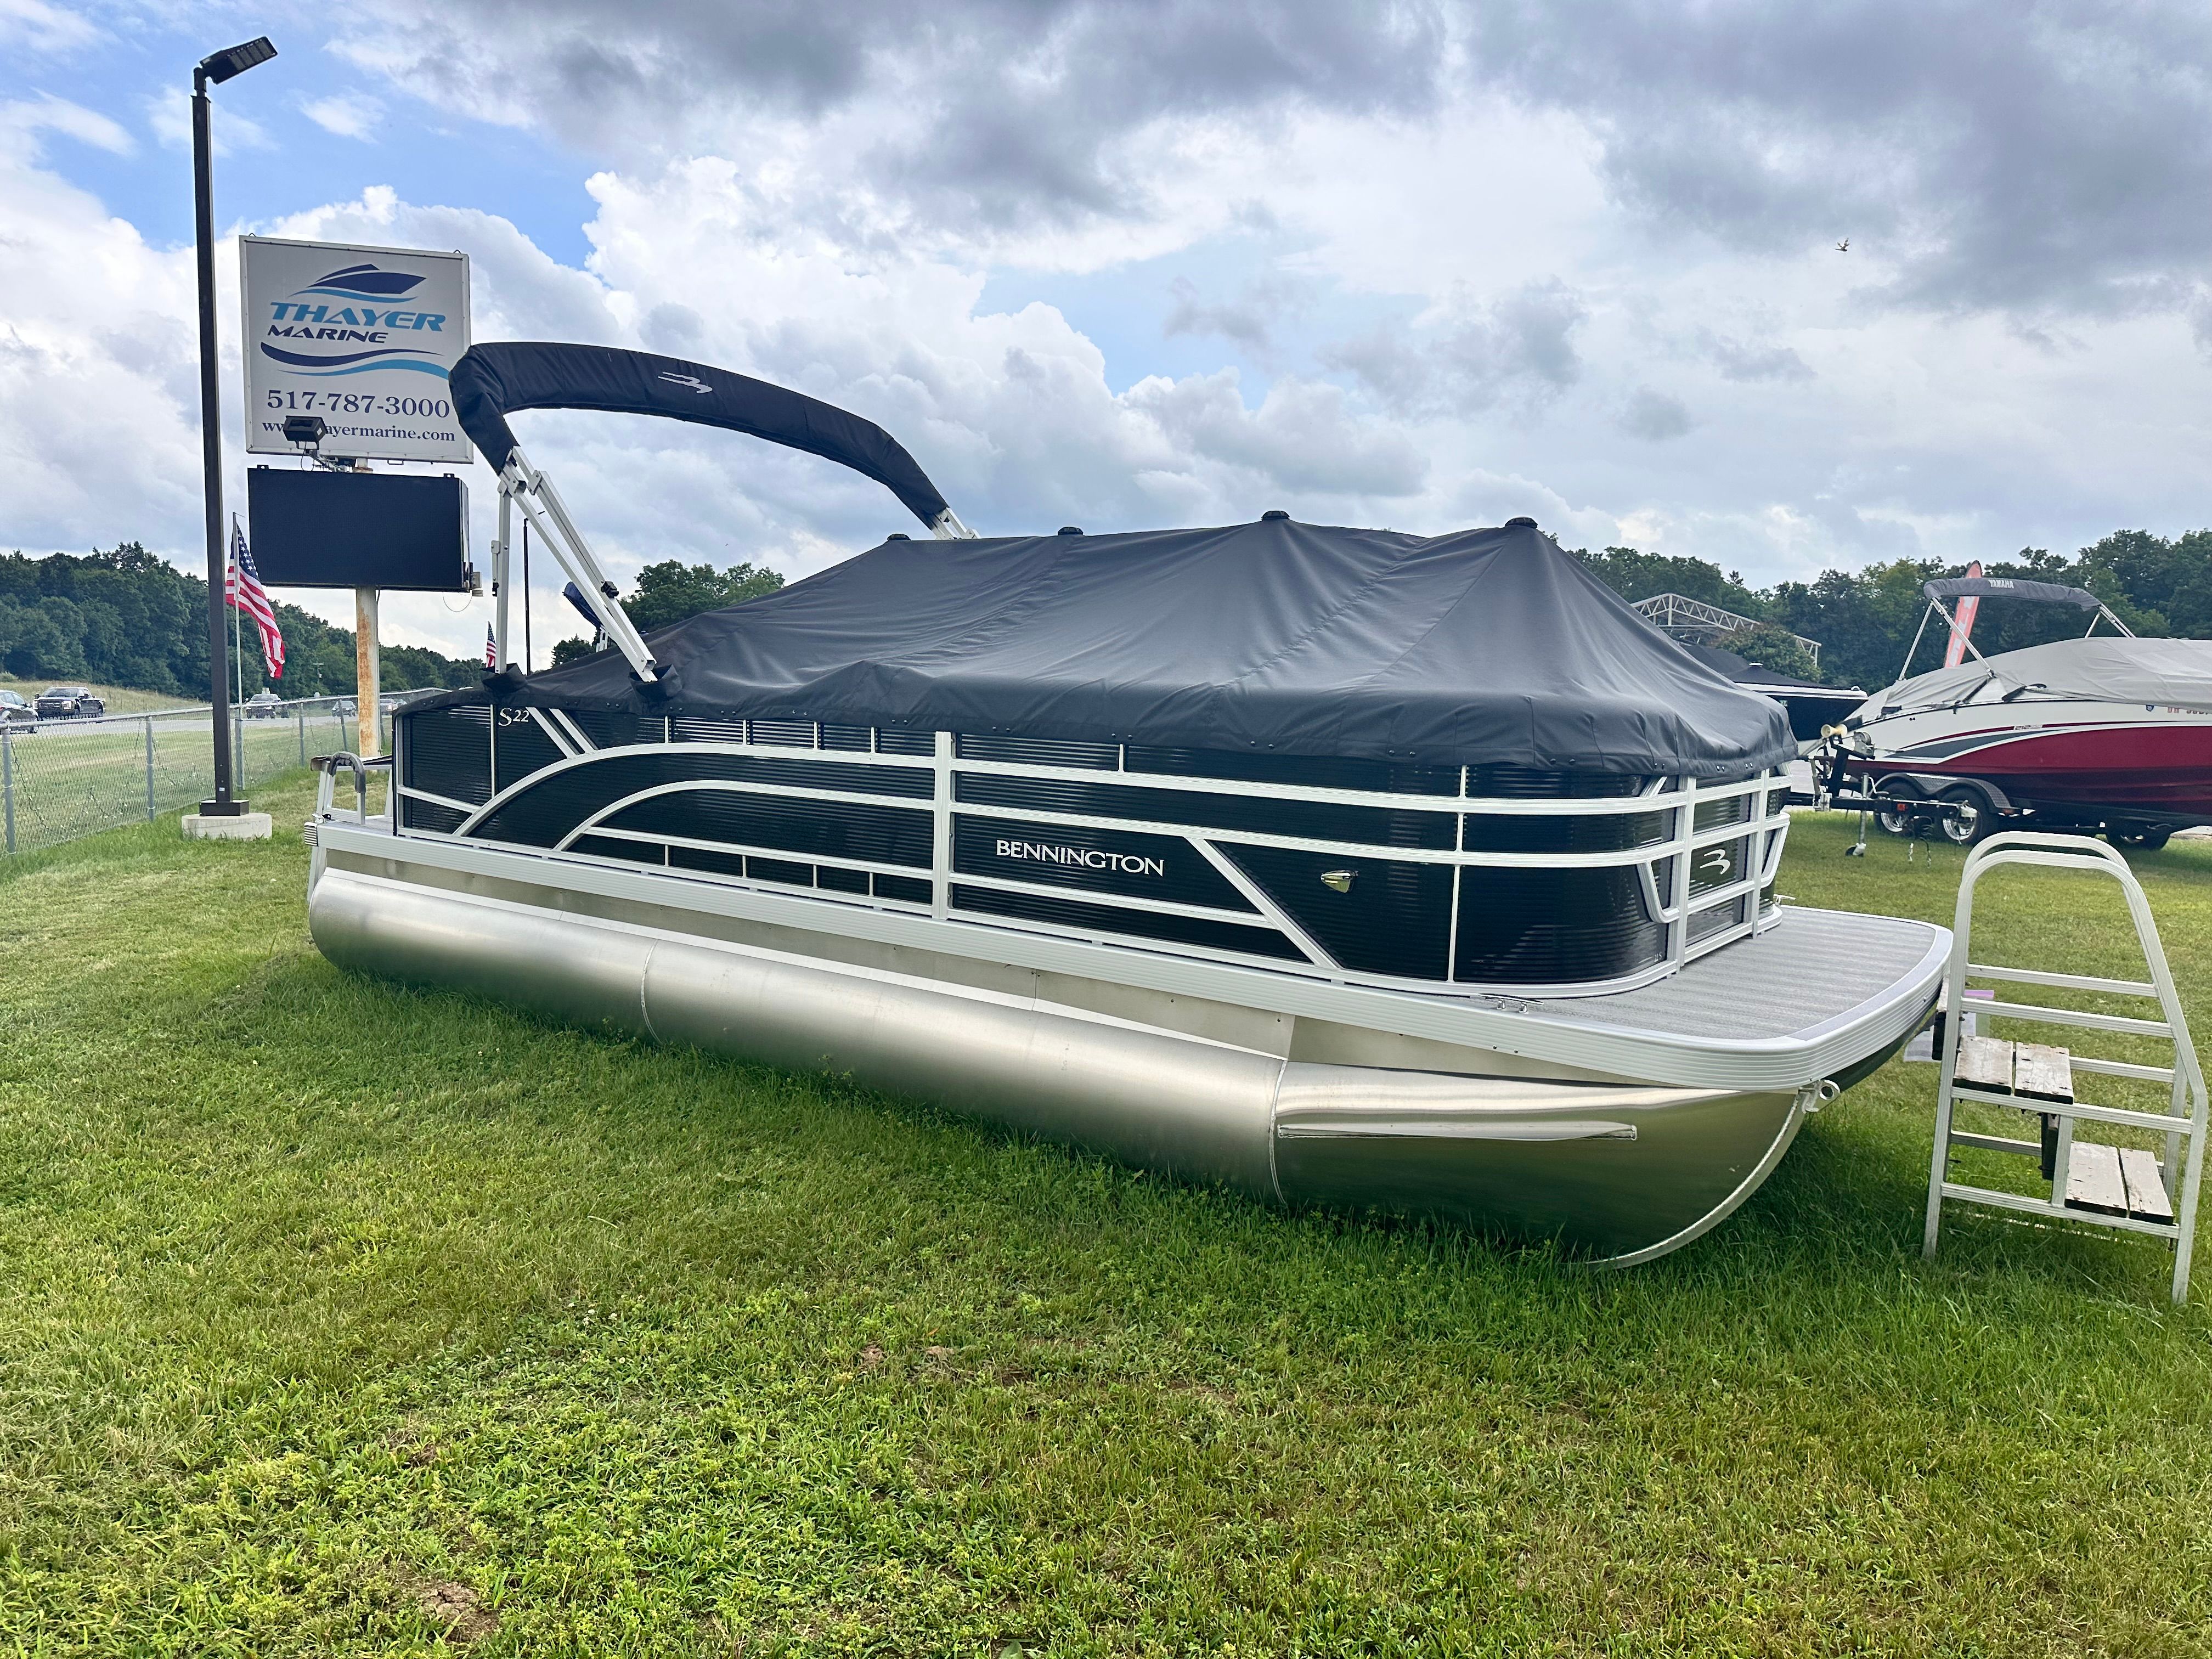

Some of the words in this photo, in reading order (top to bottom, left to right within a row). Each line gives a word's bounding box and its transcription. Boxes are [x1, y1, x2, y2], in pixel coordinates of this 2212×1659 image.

[270, 302, 446, 331] THAYER
[267, 325, 388, 343] MARINE
[267, 390, 449, 418] 517-787-3000
[262, 422, 455, 441] wwayermarine.com
[1988, 579, 2014, 589] YAMAHA
[996, 839, 1165, 877] BENNINGTON
